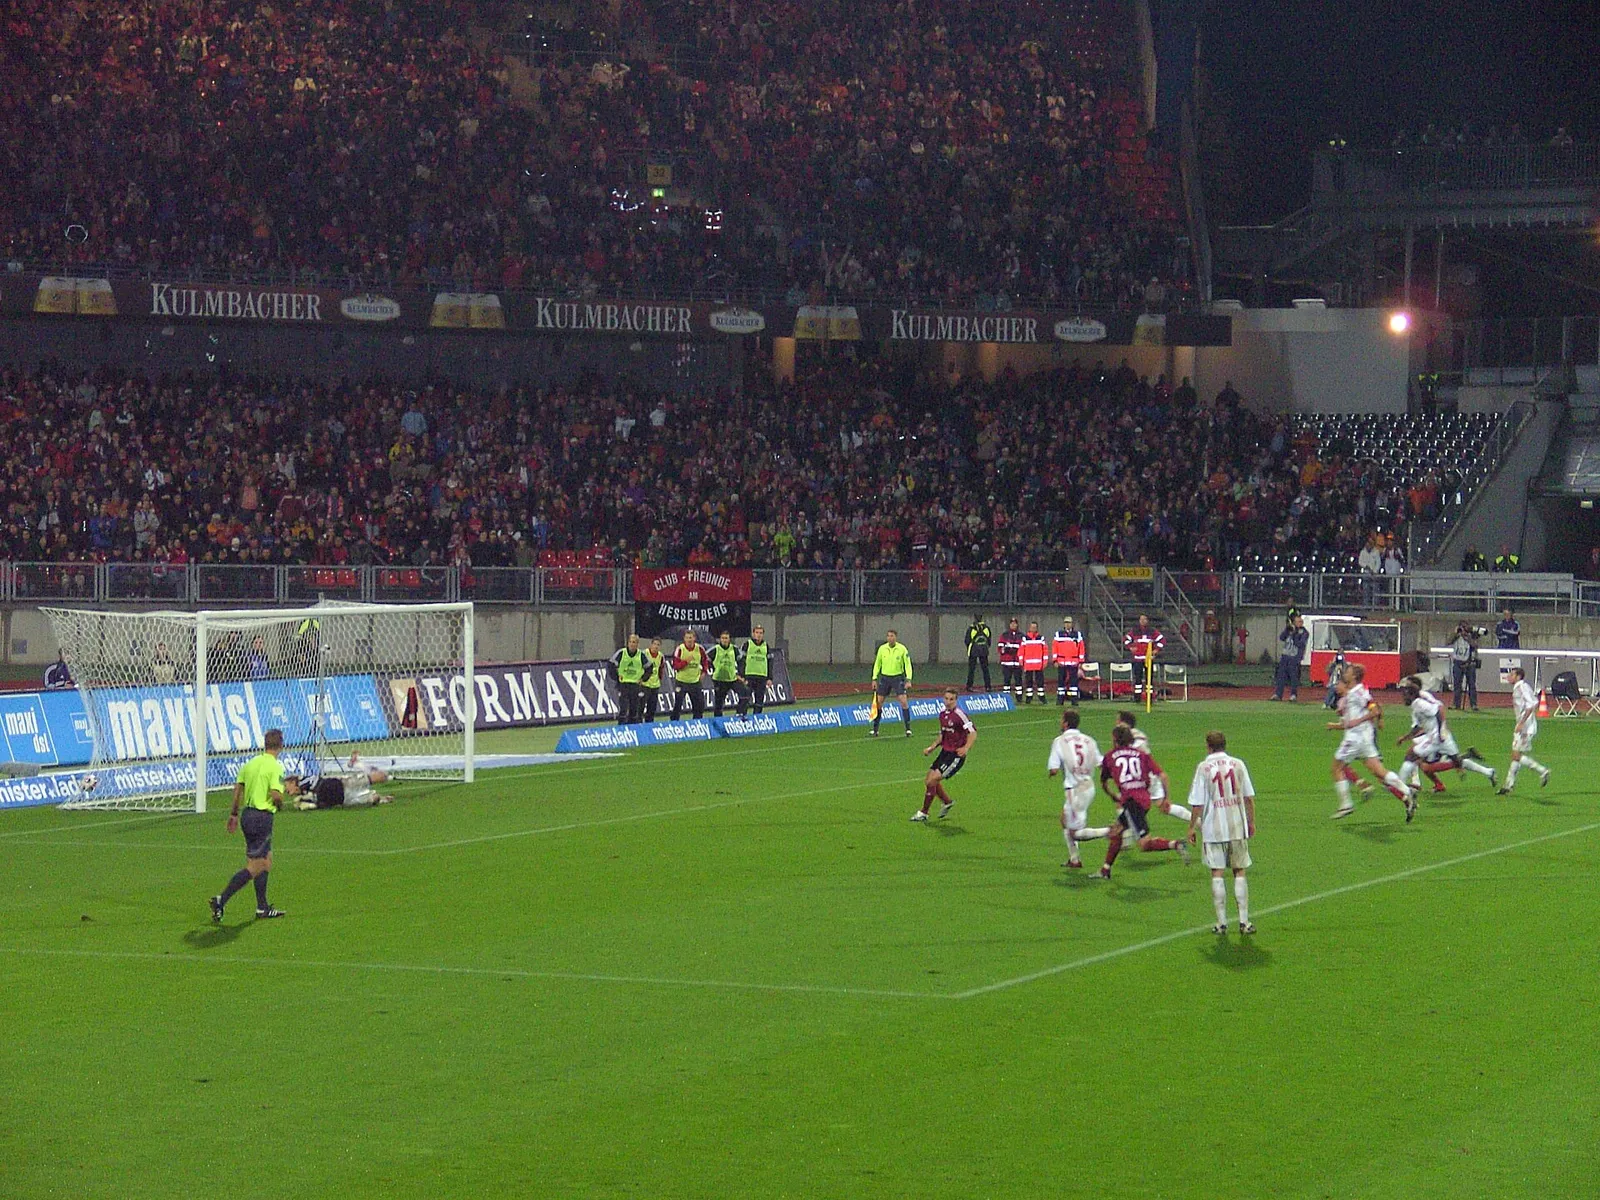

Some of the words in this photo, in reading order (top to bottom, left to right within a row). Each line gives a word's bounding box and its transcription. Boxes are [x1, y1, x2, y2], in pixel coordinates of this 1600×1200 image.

[150, 283, 321, 320] KULMBACHER
[535, 297, 692, 333] KULMBACHER
[890, 309, 1038, 343] KULMBACHER
[653, 572, 678, 591] CLUB
[688, 569, 731, 590] FREUNDE
[689, 591, 699, 600] AM
[658, 602, 728, 621] HESSELBERG
[421, 668, 620, 727] FORMAXX
[5, 707, 39, 736] maxi
[33, 732, 51, 753] dsl
[1074, 743, 1084, 767] 5
[1115, 756, 1142, 784] 20
[1212, 768, 1236, 798] 11
